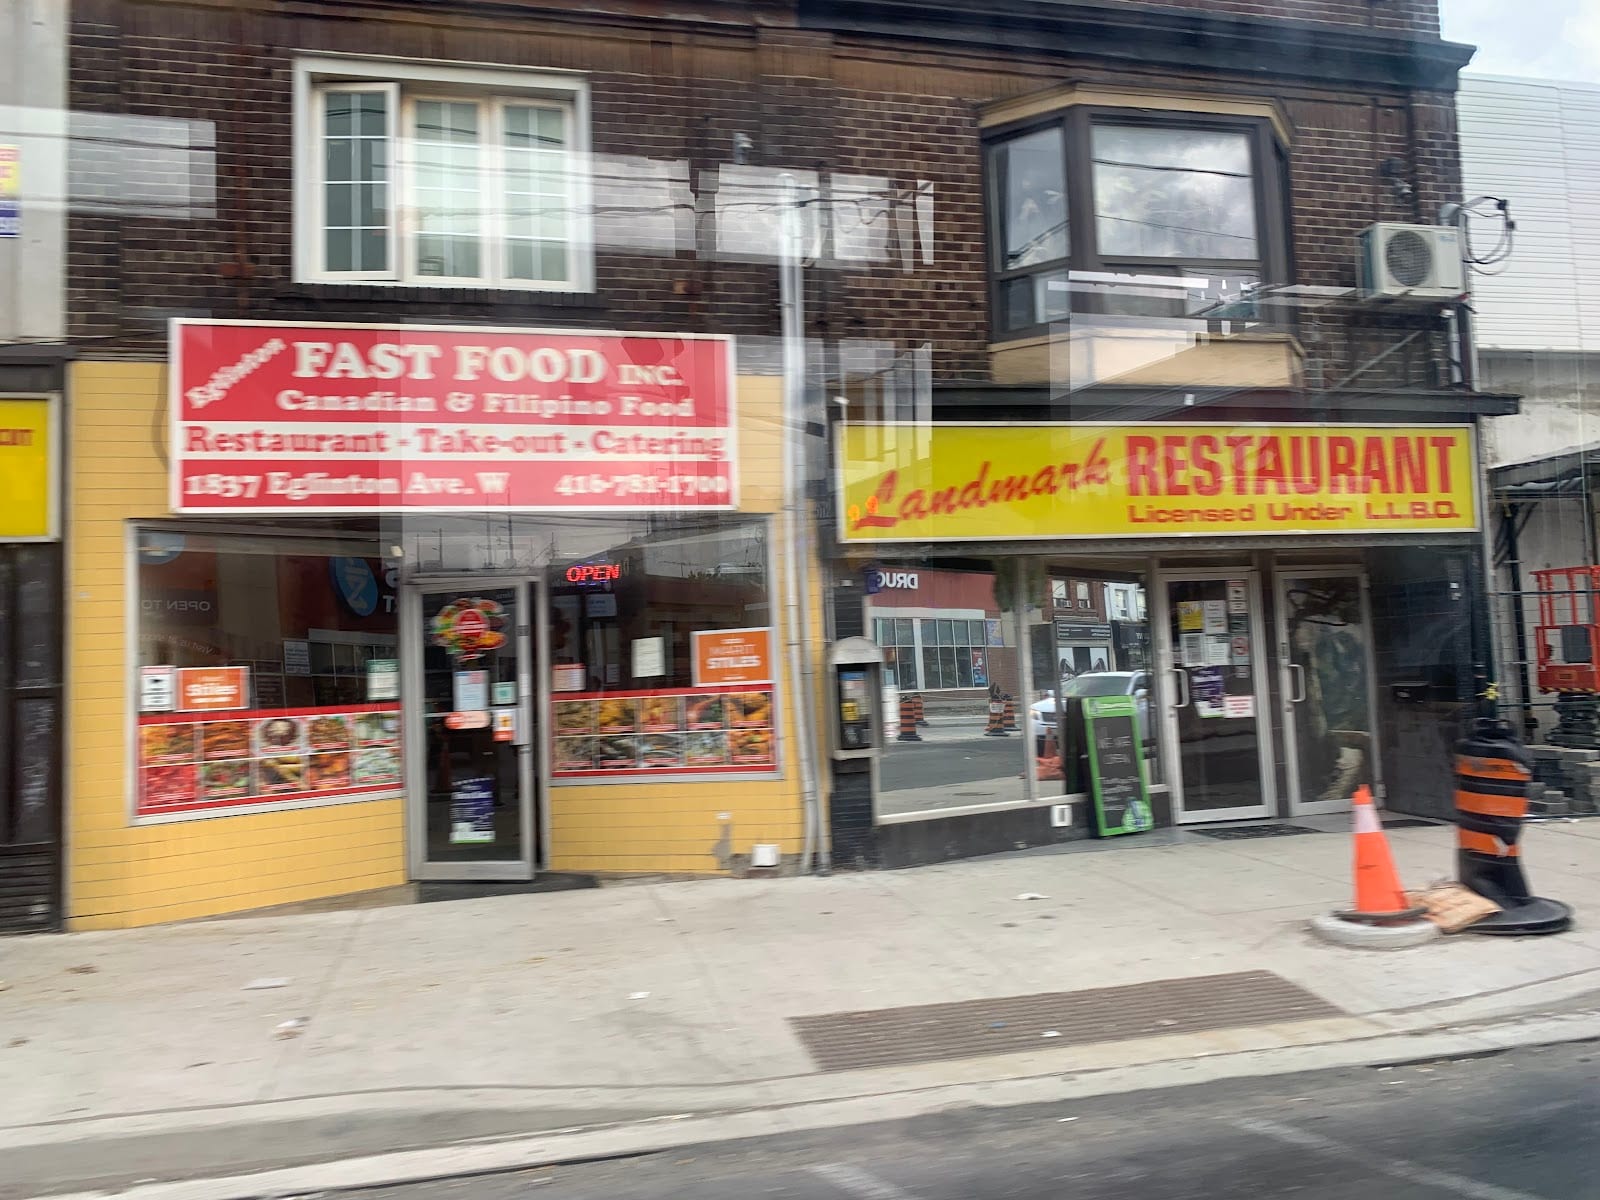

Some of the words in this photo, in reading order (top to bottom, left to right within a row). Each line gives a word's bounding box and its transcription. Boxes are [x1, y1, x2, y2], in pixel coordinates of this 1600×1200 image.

[291, 341, 443, 380] FAST
[453, 345, 606, 383] FOOD
[617, 364, 684, 386] INC.
[276, 389, 438, 412] Canadian
[445, 391, 475, 413] &
[482, 392, 613, 418] Filipino
[618, 396, 696, 416] Food
[184, 425, 389, 453] Restaurant
[415, 427, 567, 455] Take-out
[591, 430, 727, 460] Catering
[476, 472, 510, 494] W
[852, 437, 1110, 531] Landmark
[1124, 435, 1457, 496] RESTAURANT
[1128, 504, 1256, 523] Licensed
[1267, 502, 1352, 522] Under
[566, 564, 620, 582] OPEN
